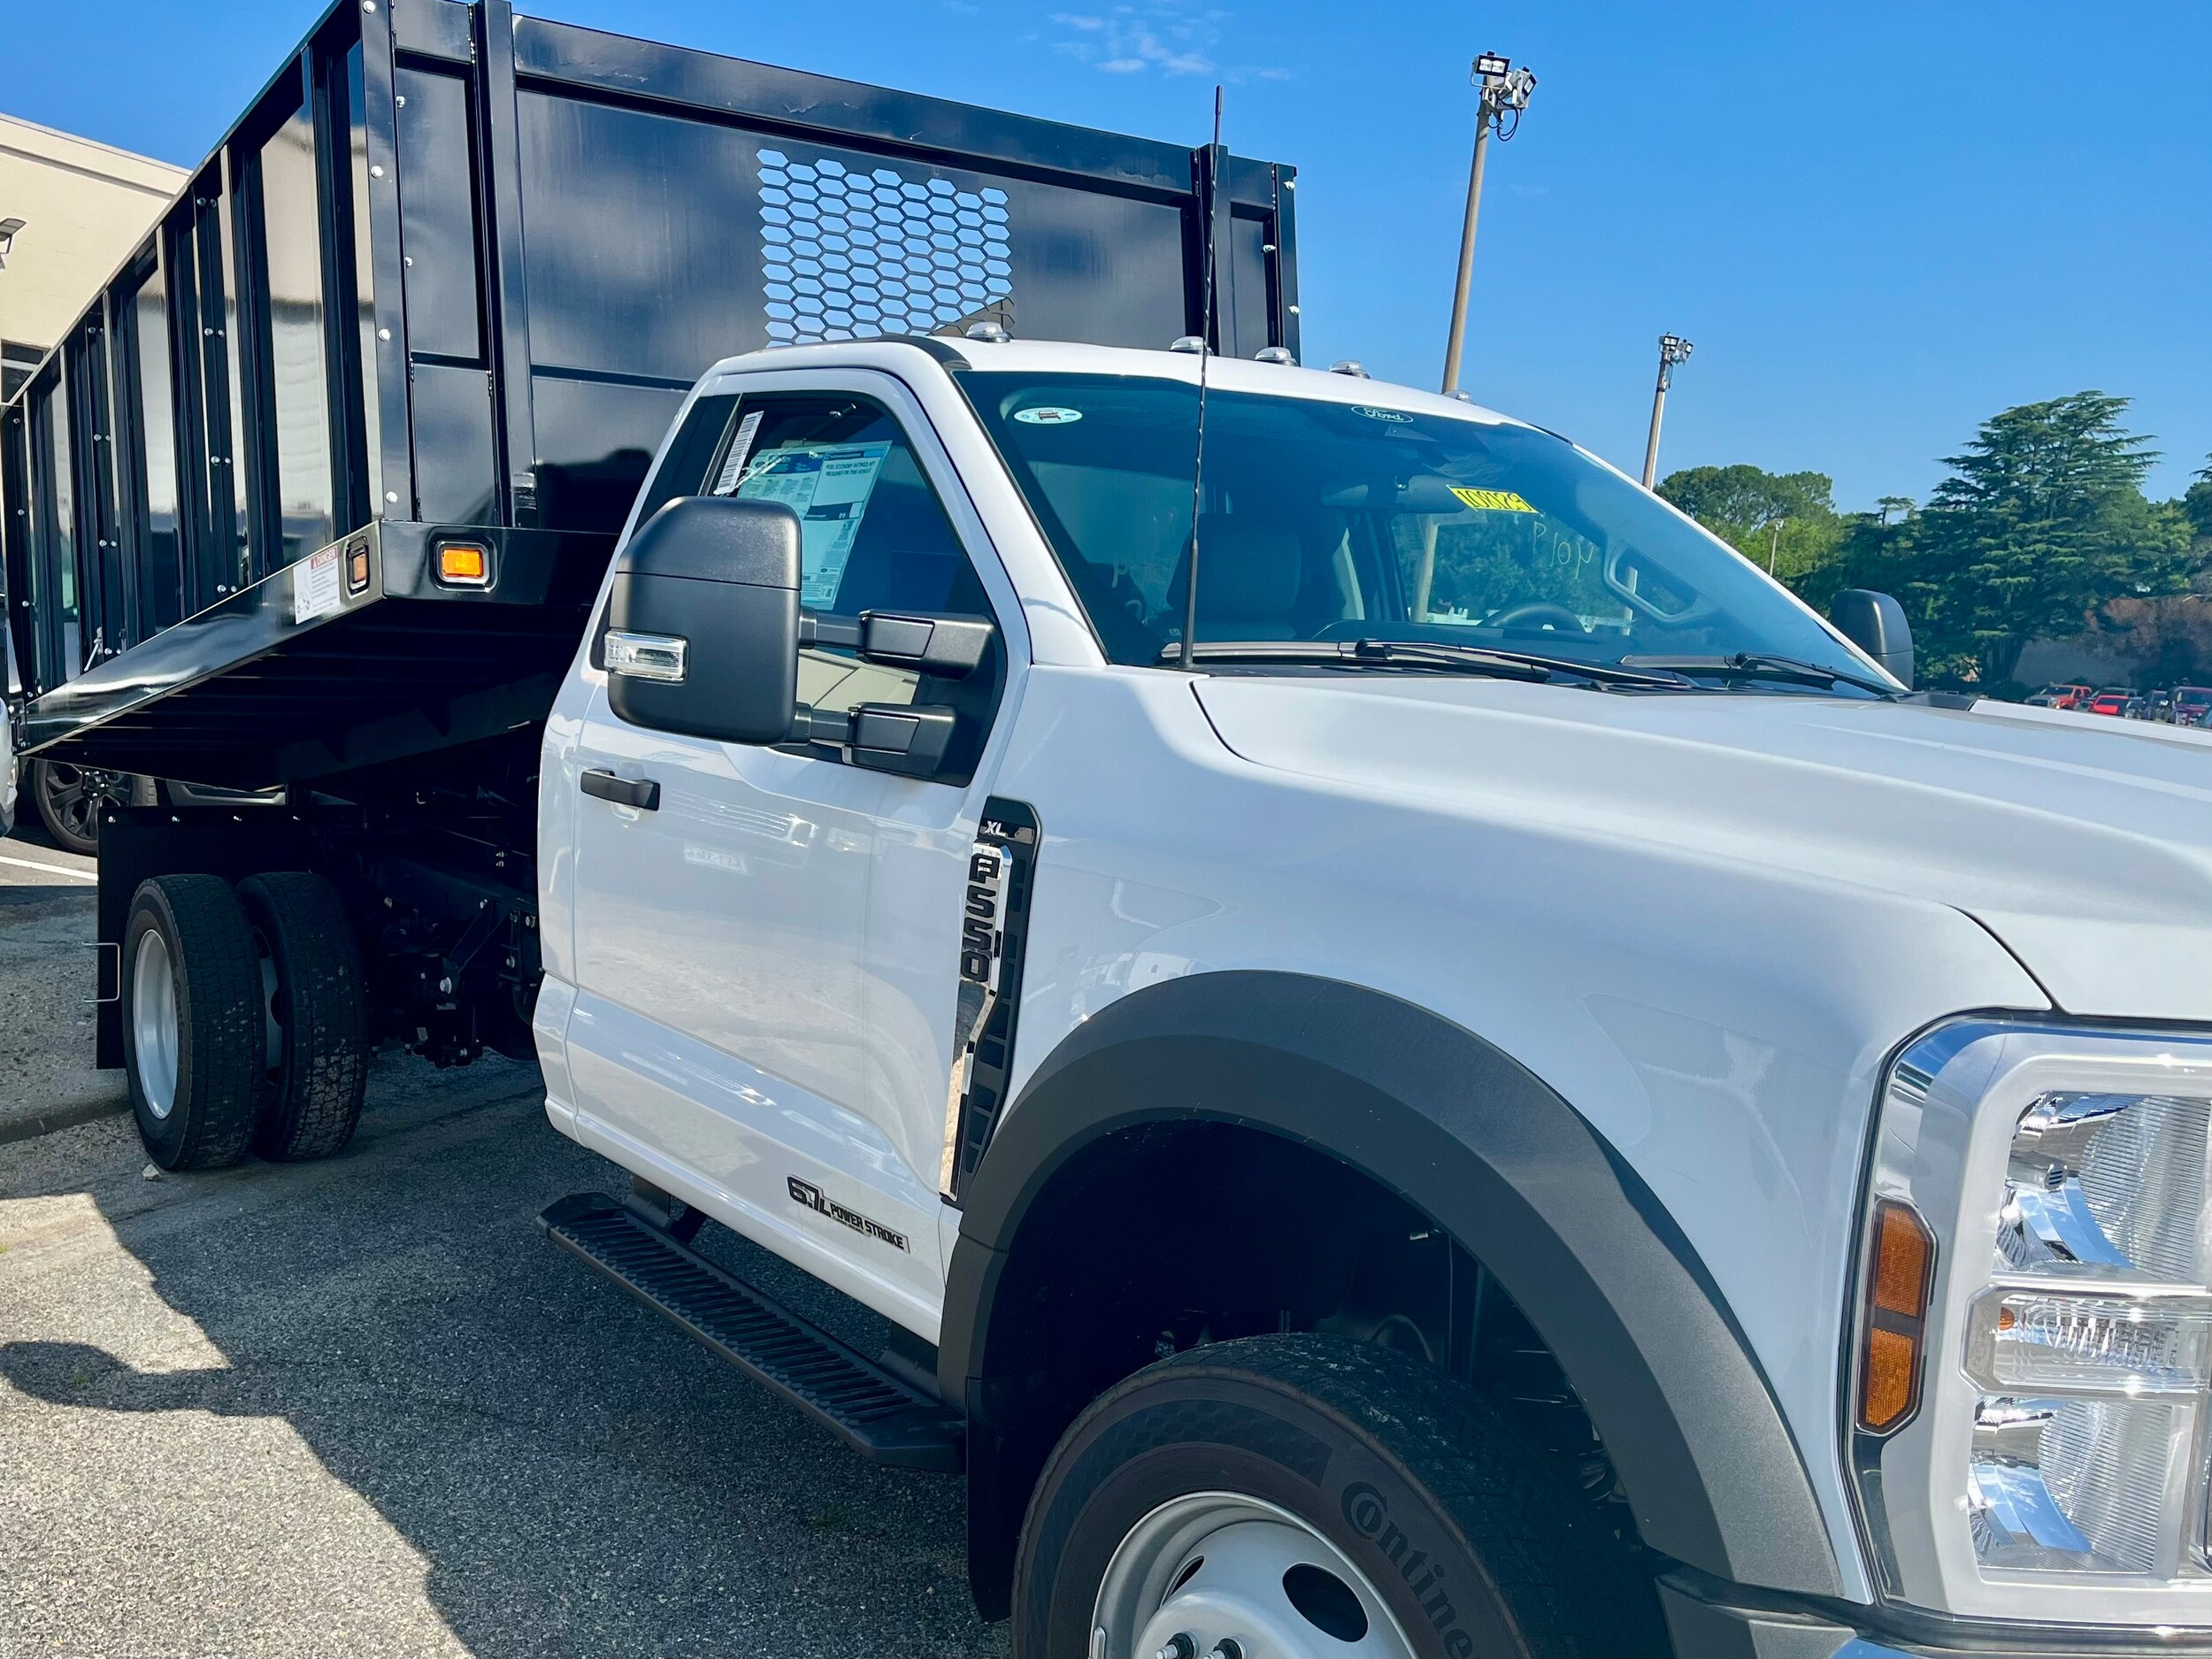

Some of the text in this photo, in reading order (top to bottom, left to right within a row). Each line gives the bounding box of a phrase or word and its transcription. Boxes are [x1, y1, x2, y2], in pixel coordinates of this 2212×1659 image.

[1363, 407, 1404, 421] Ford
[317, 549, 336, 566] DANGER
[985, 820, 1007, 837] XL
[830, 1202, 864, 1230] POWER
[864, 1220, 904, 1249] STROKE
